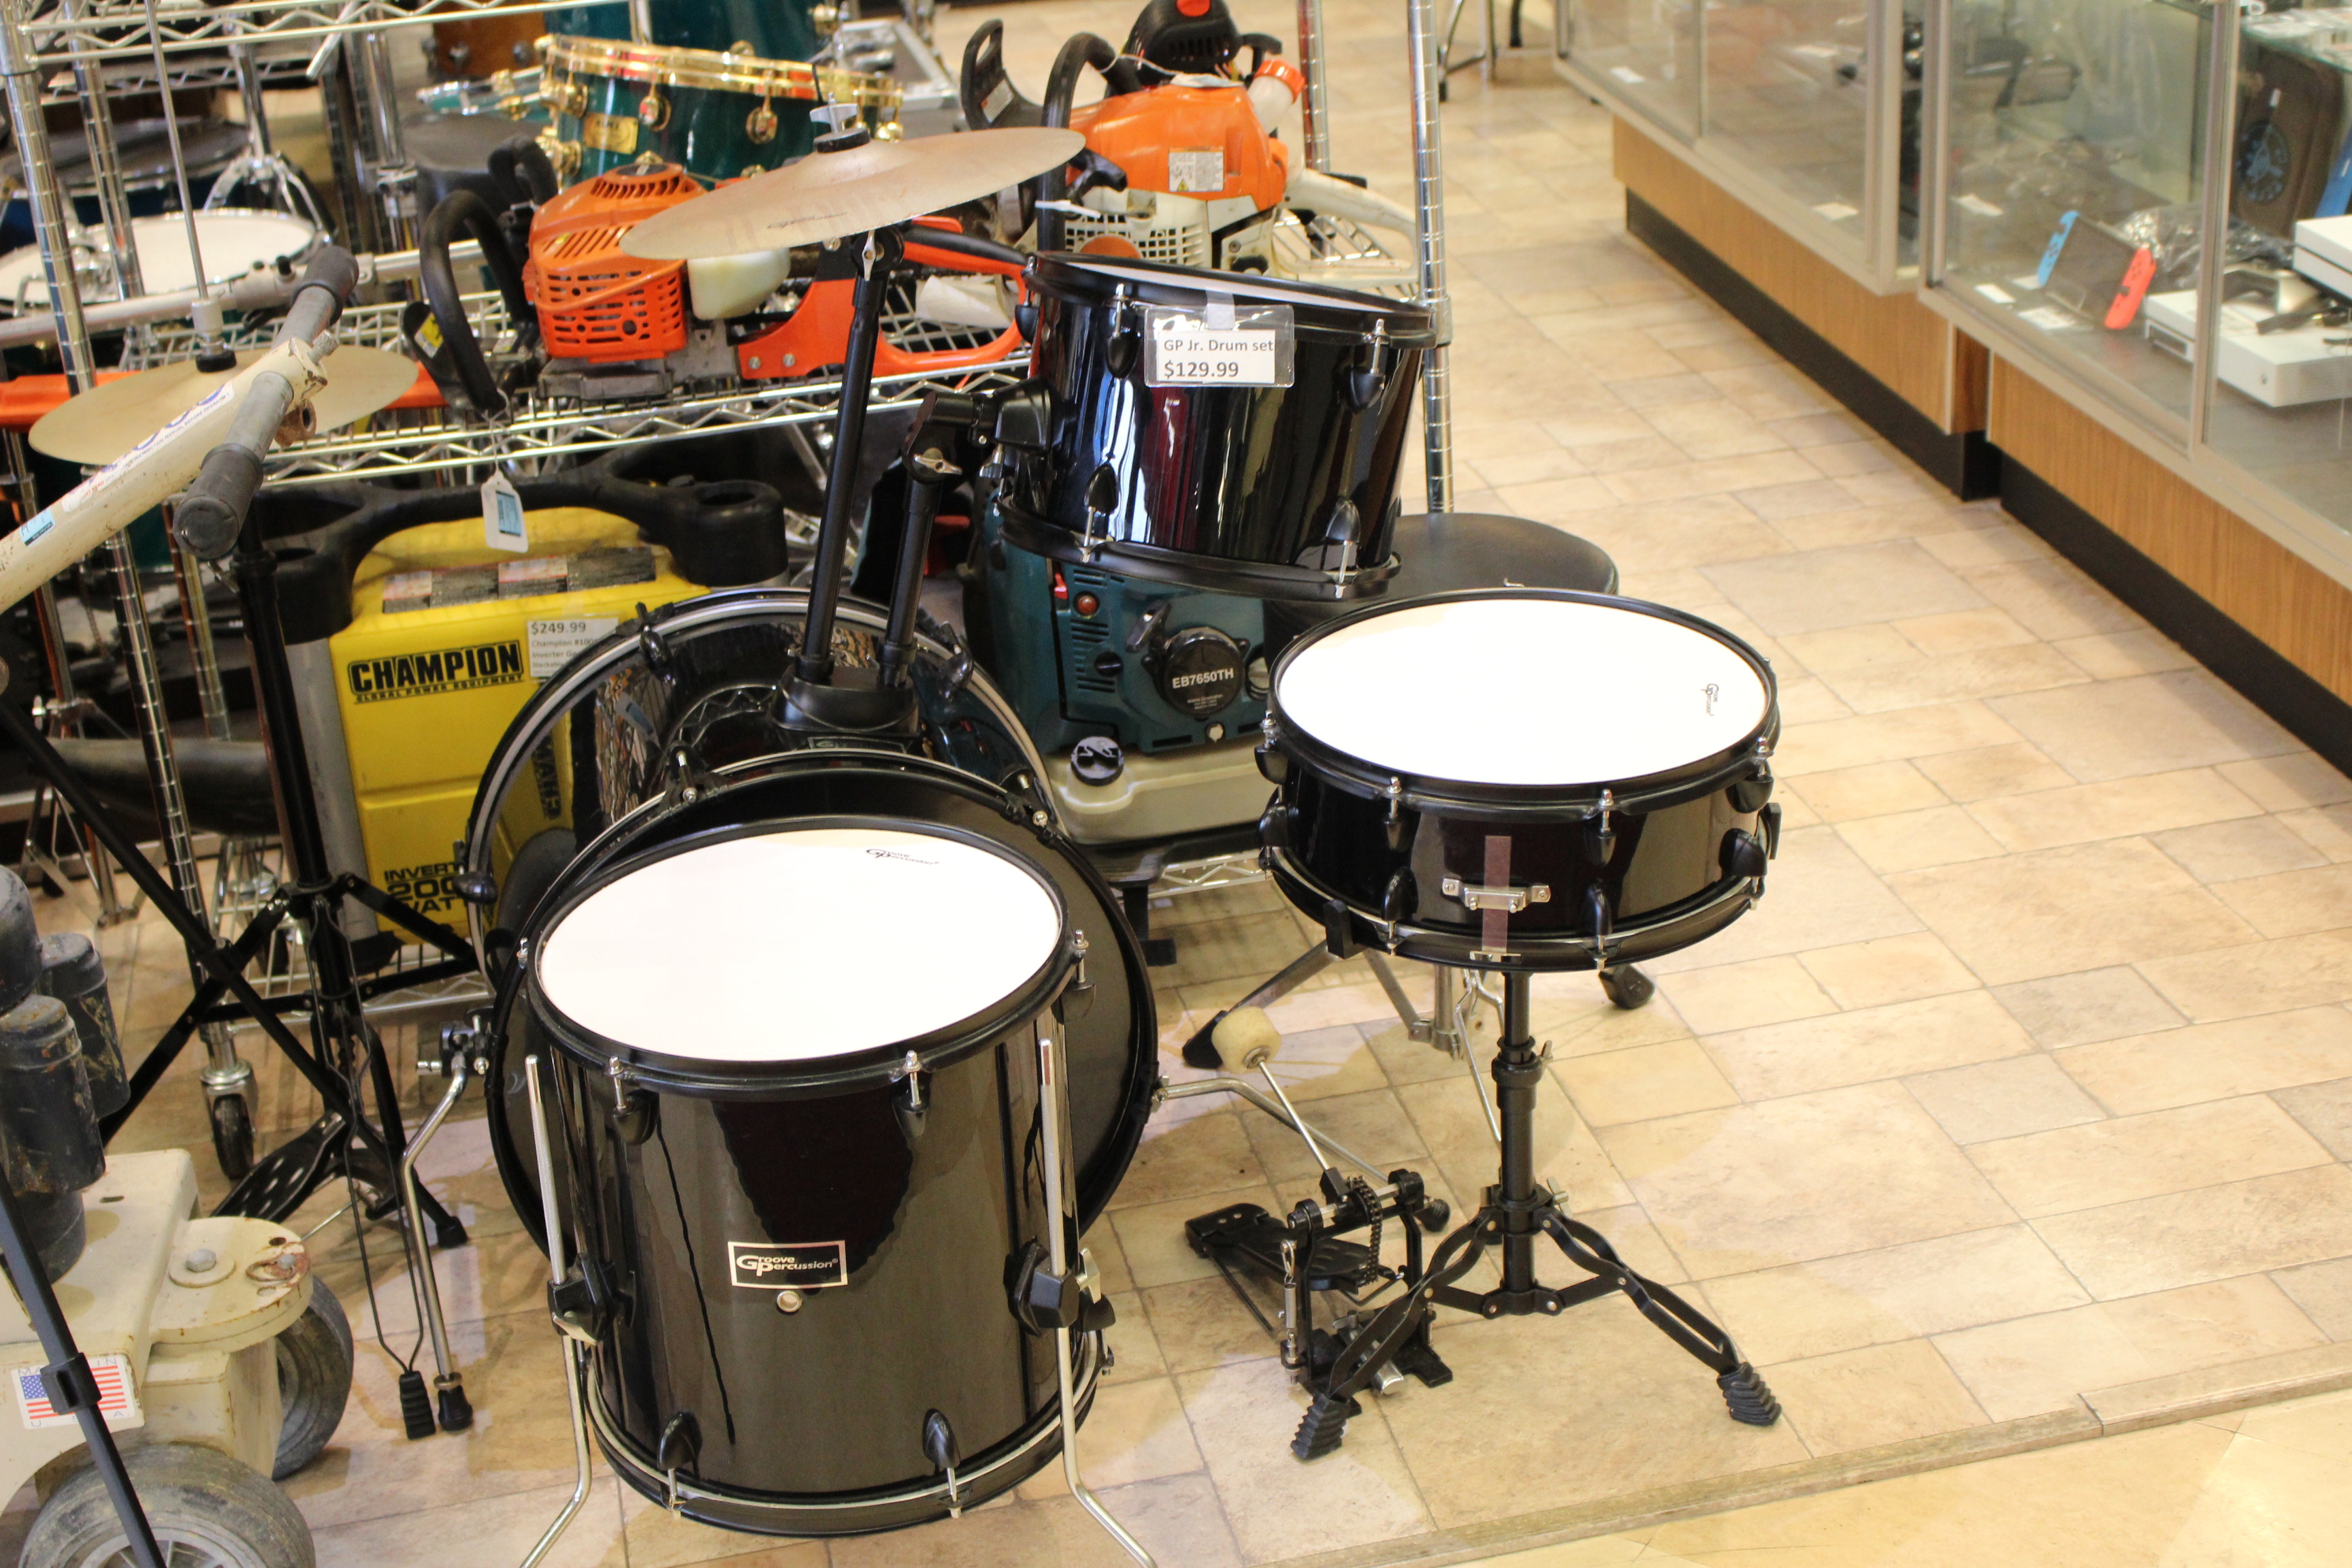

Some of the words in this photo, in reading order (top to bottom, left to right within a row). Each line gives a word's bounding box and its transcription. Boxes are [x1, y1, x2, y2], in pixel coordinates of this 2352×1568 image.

[1164, 340, 1183, 351] GP
[1188, 340, 1204, 351] Jr.
[1209, 340, 1248, 351] Drum
[1252, 340, 1274, 351] set
[1164, 359, 1239, 379] $129.99
[531, 621, 587, 635] $249.99
[532, 639, 572, 648] Champion
[350, 643, 521, 693] CHAMPION
[1172, 668, 1234, 689] EB7650TH
[357, 690, 401, 702] GLOBAL
[407, 683, 448, 696] POWER
[453, 674, 522, 691] EQUIPMENT
[736, 1254, 796, 1271] Groove
[97, 1358, 118, 1368] IN
